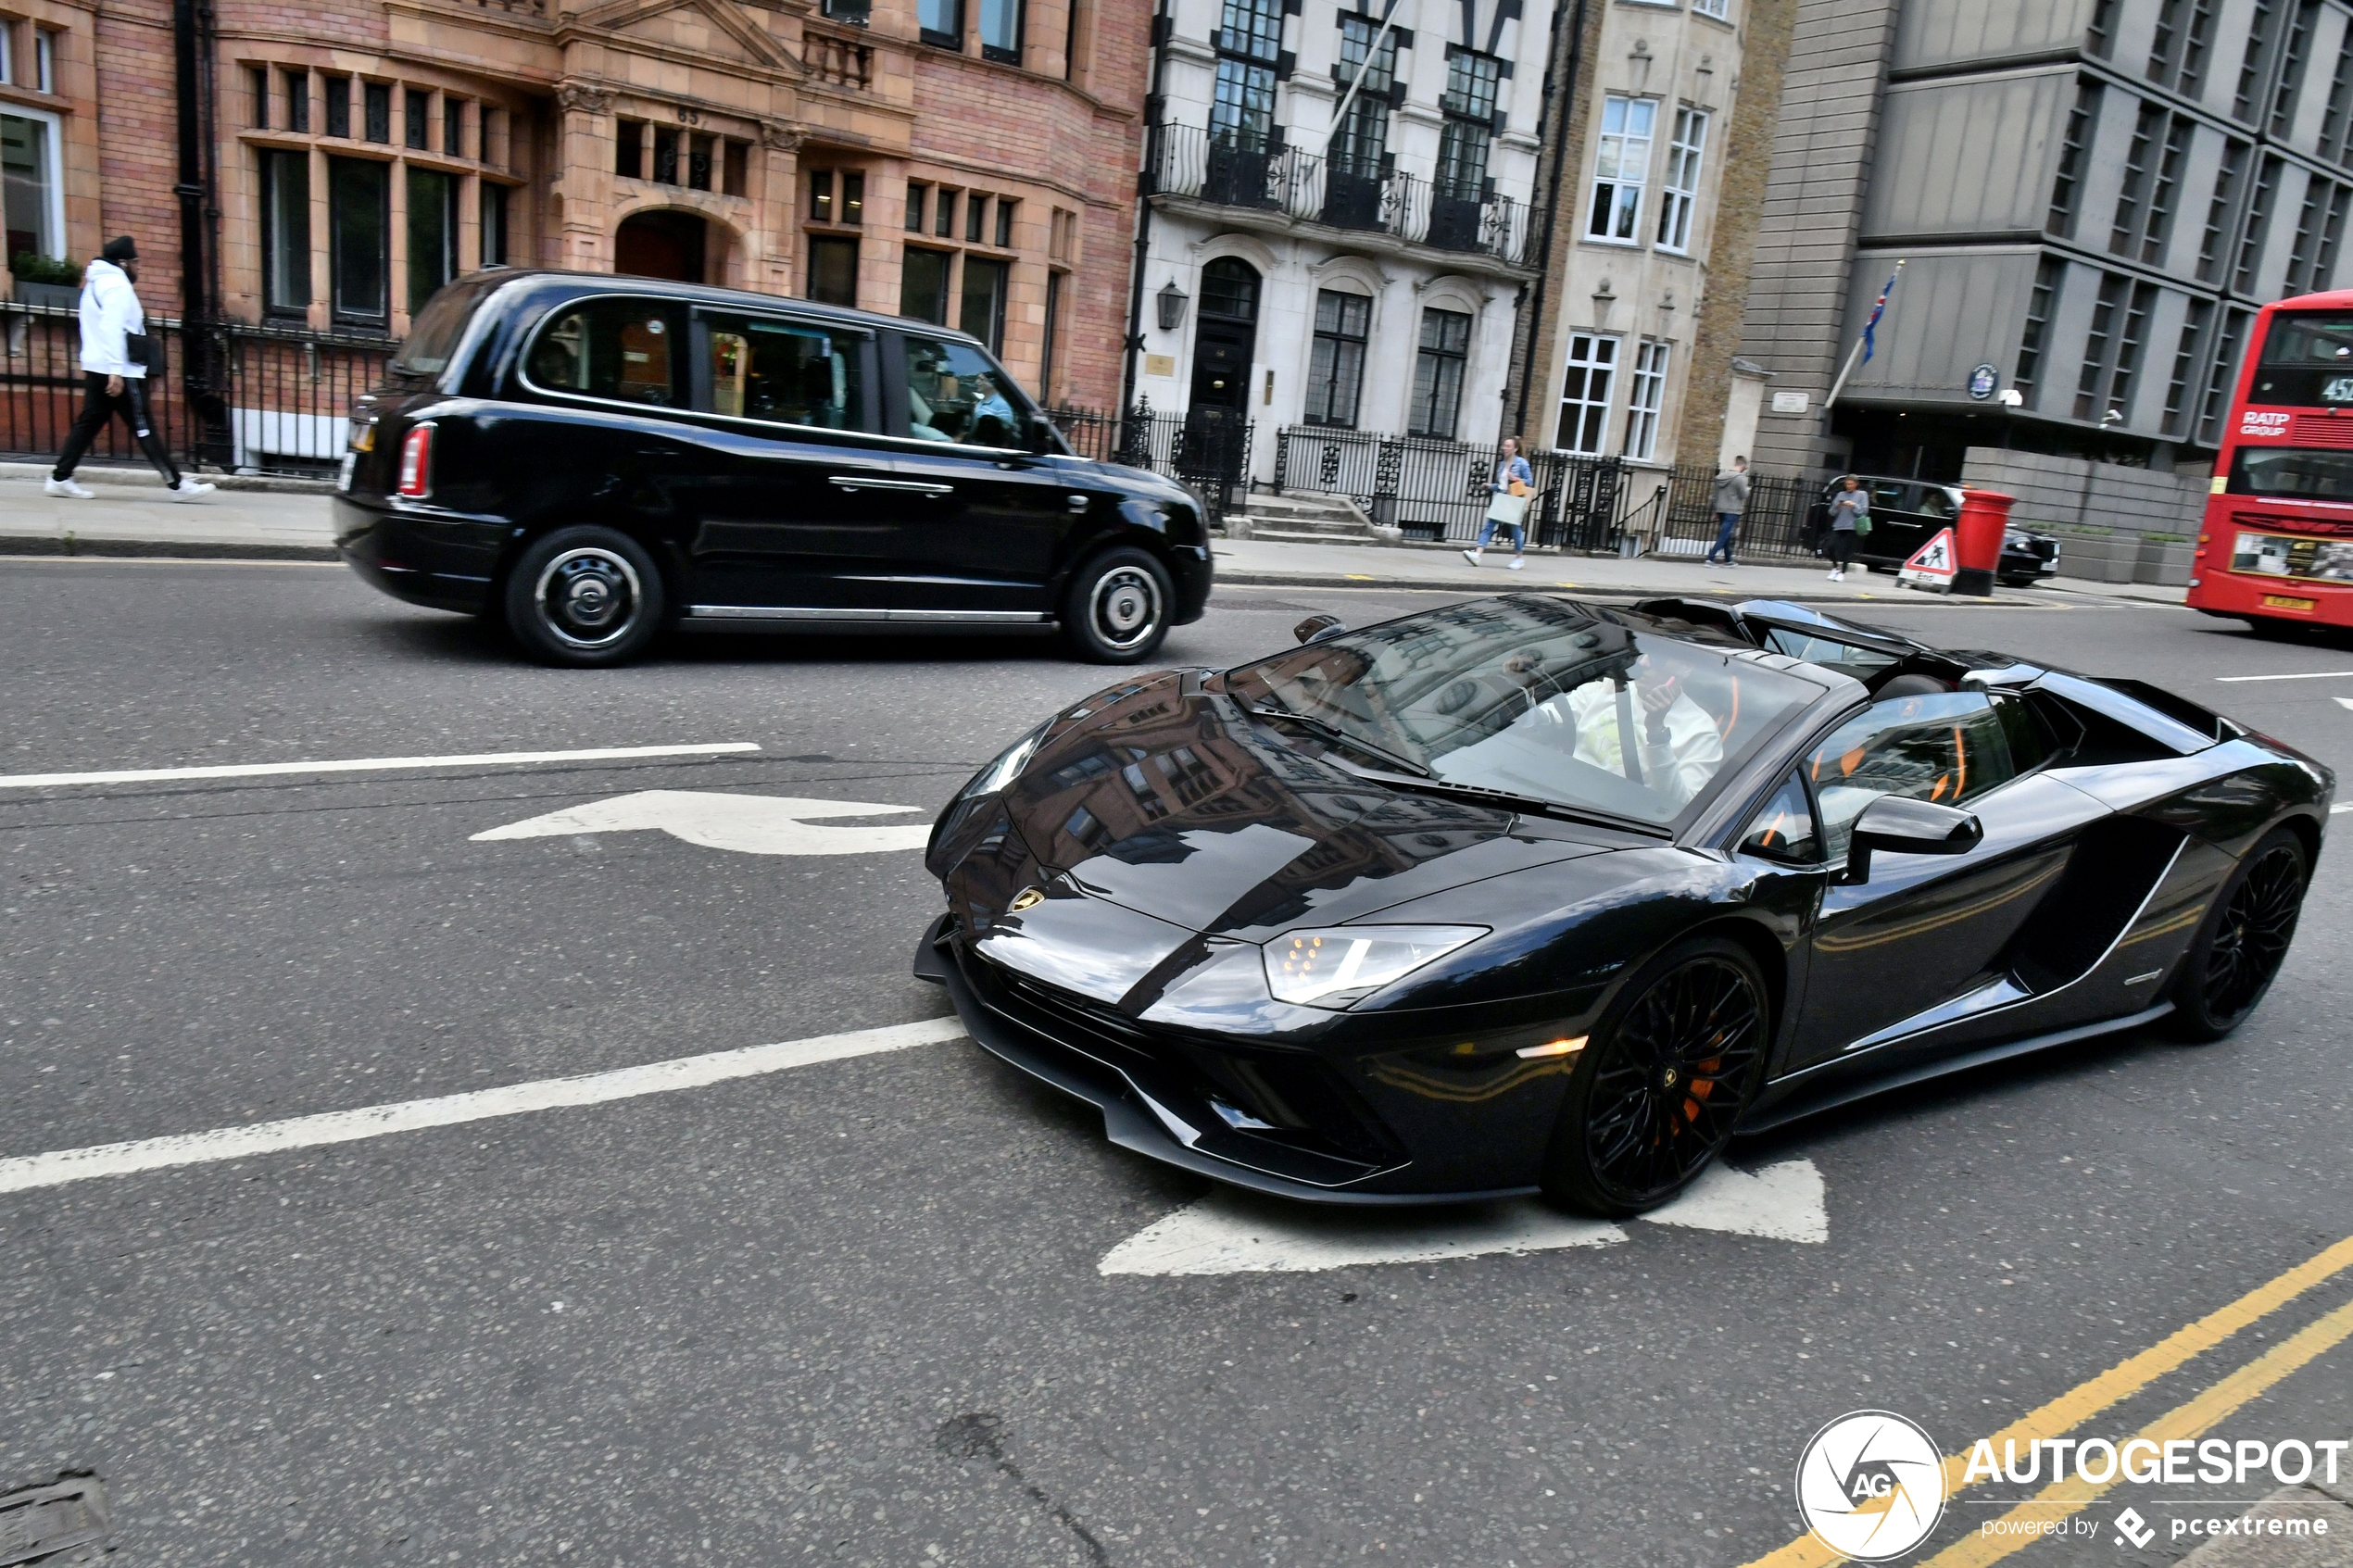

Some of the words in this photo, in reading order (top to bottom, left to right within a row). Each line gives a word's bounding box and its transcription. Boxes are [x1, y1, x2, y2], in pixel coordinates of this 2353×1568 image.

[677, 107, 698, 125] 65
[2242, 411, 2290, 426] RATP
[1918, 572, 1934, 583] End
